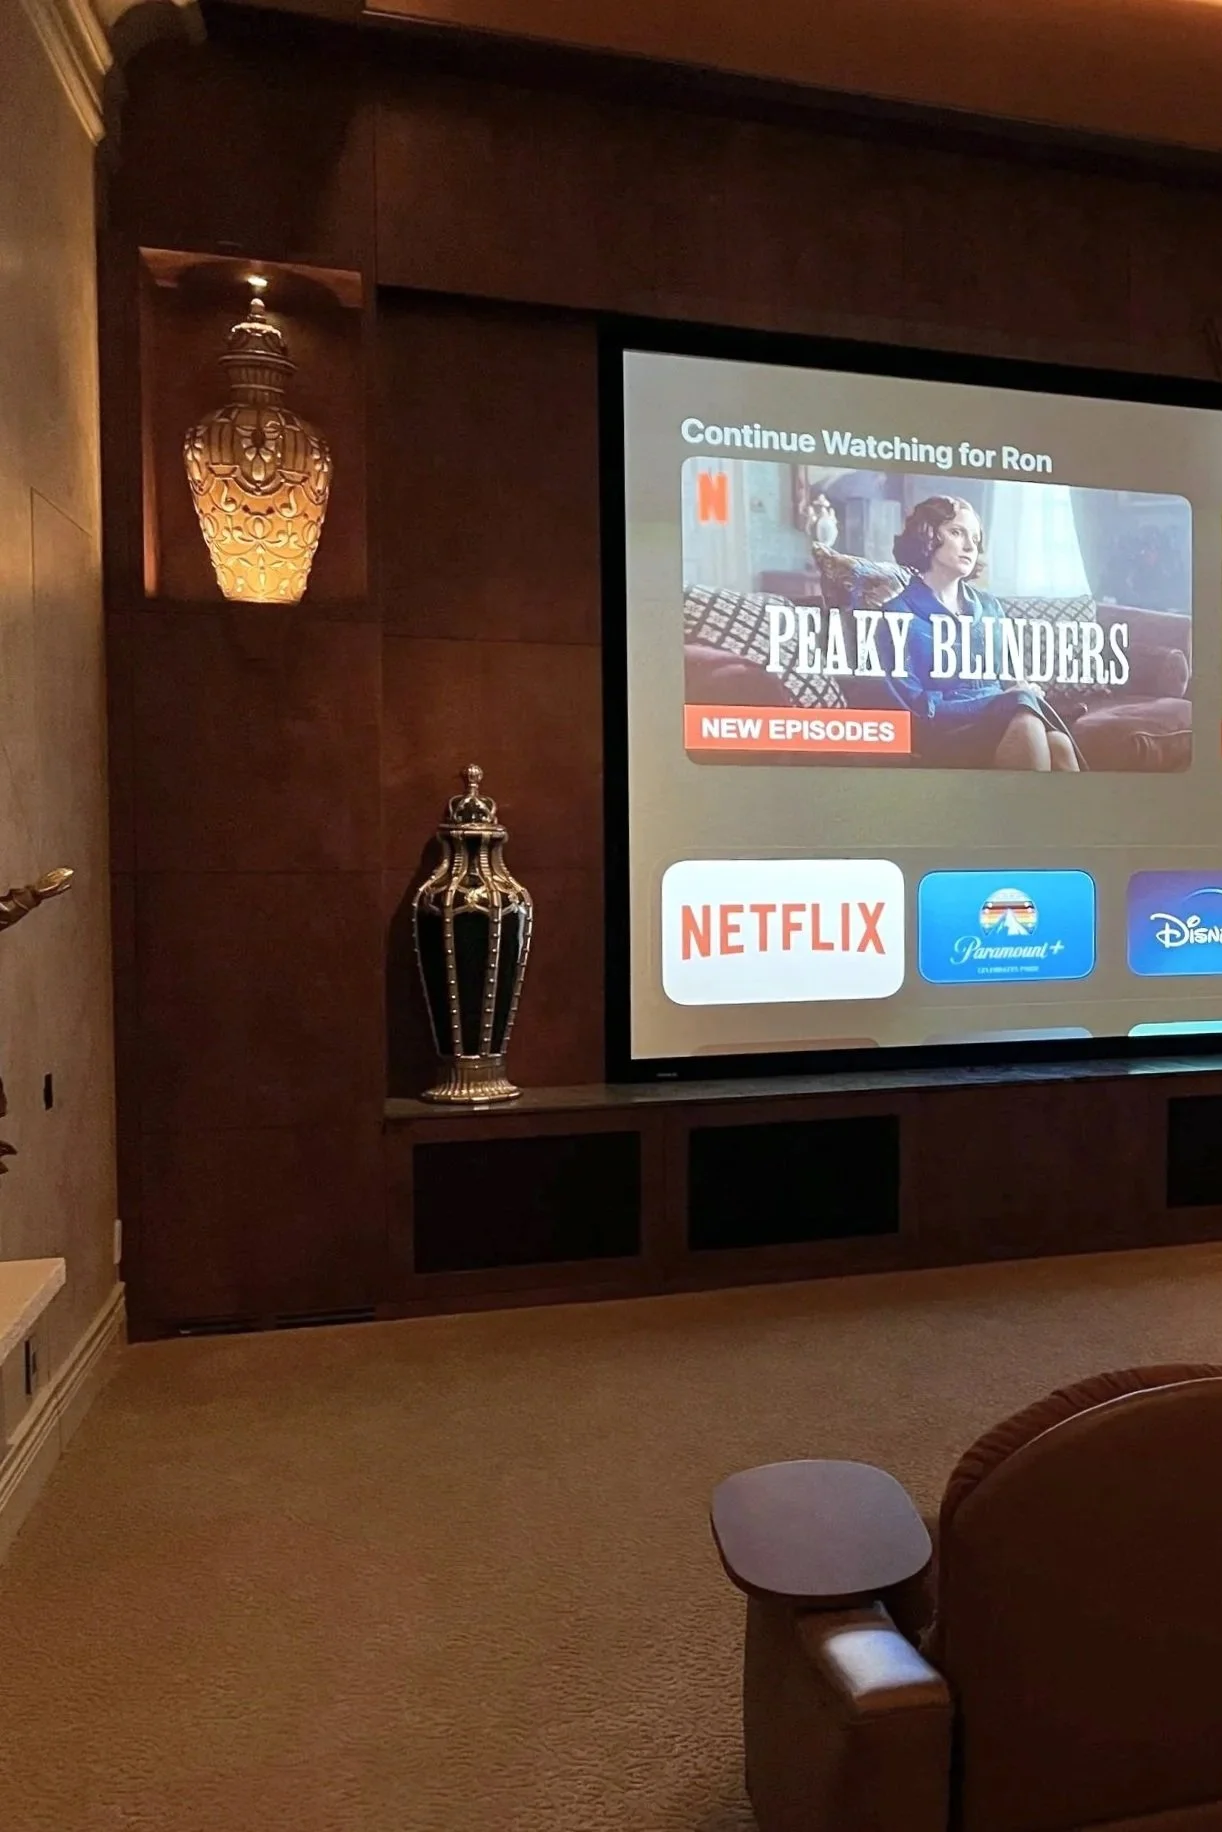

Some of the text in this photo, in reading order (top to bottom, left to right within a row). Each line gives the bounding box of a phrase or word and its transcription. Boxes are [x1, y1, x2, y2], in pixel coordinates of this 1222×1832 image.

[681, 418, 1053, 473] Continue Watching for Ron
[698, 472, 728, 525] N
[765, 605, 1129, 685] PEAKY BLINDERS
[701, 717, 896, 742] NEW EPISODES
[681, 902, 886, 960] NETFLIX
